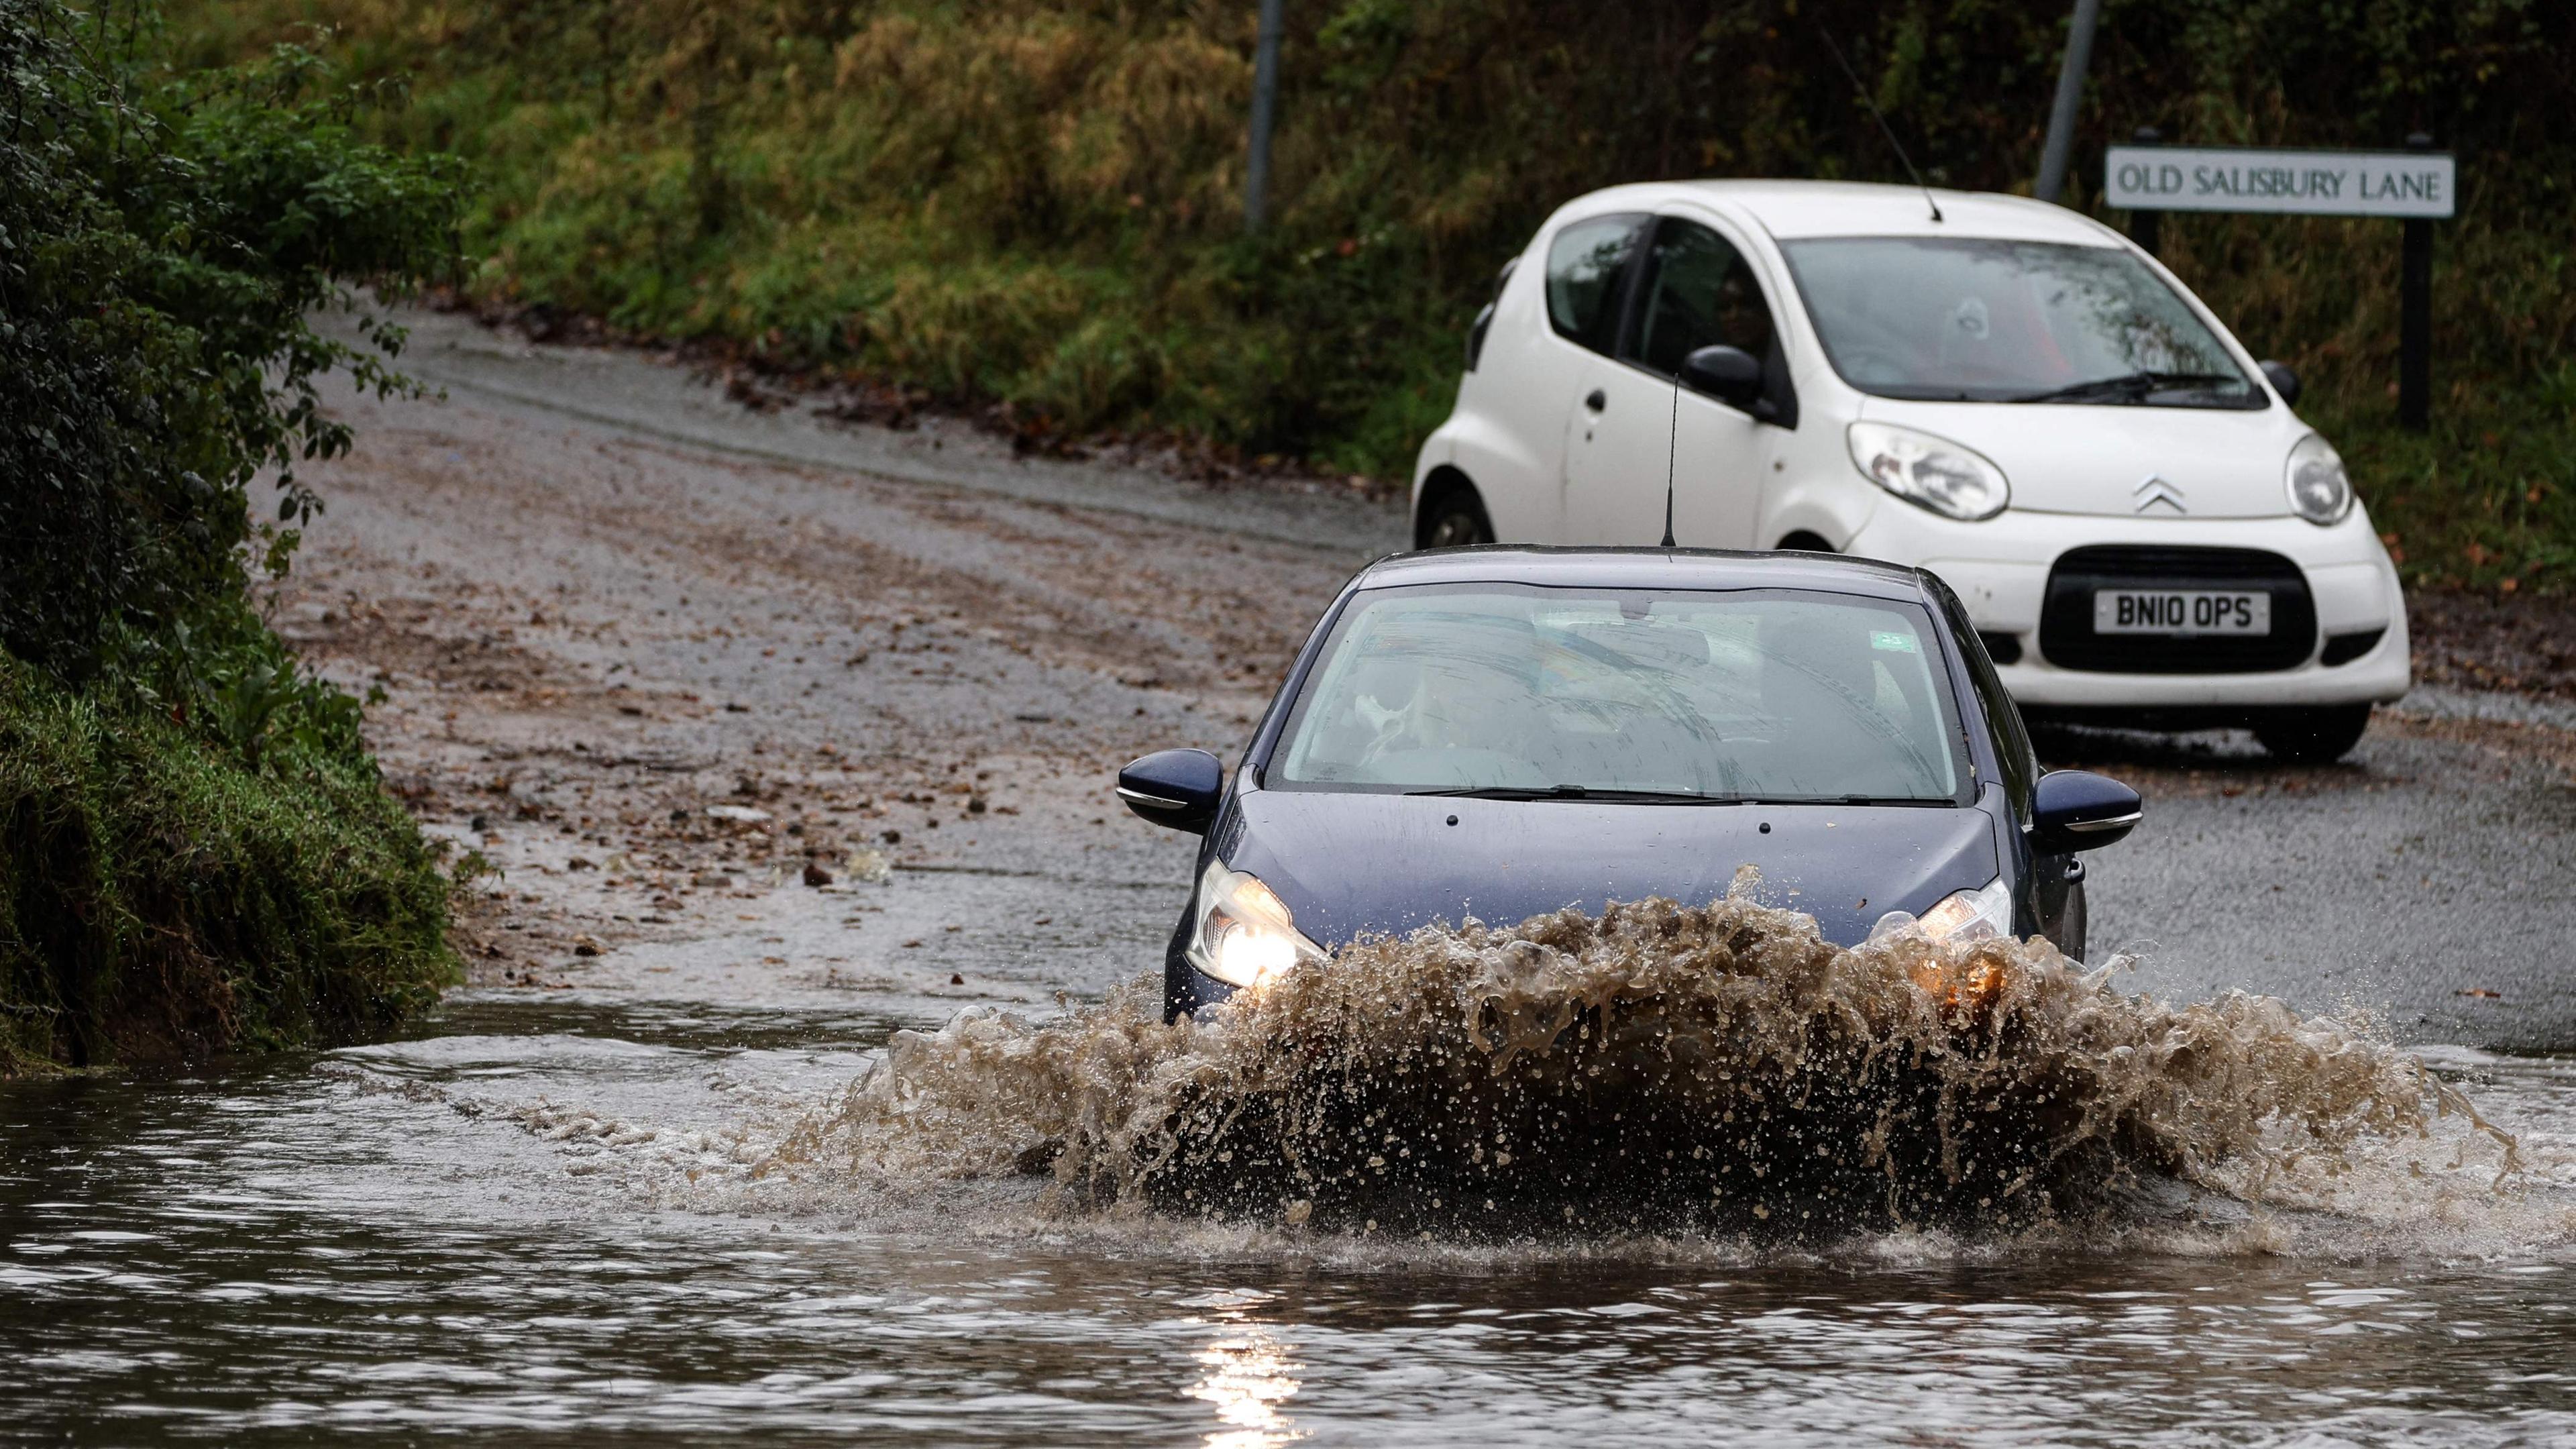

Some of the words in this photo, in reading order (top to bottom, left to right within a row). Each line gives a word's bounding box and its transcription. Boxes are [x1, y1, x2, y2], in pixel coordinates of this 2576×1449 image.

[2118, 164, 2183, 195] OLD
[2194, 166, 2345, 199] SALISBURY
[2359, 171, 2442, 201] LANE
[2116, 594, 2186, 628] BN10
[2194, 596, 2252, 629] OPS
